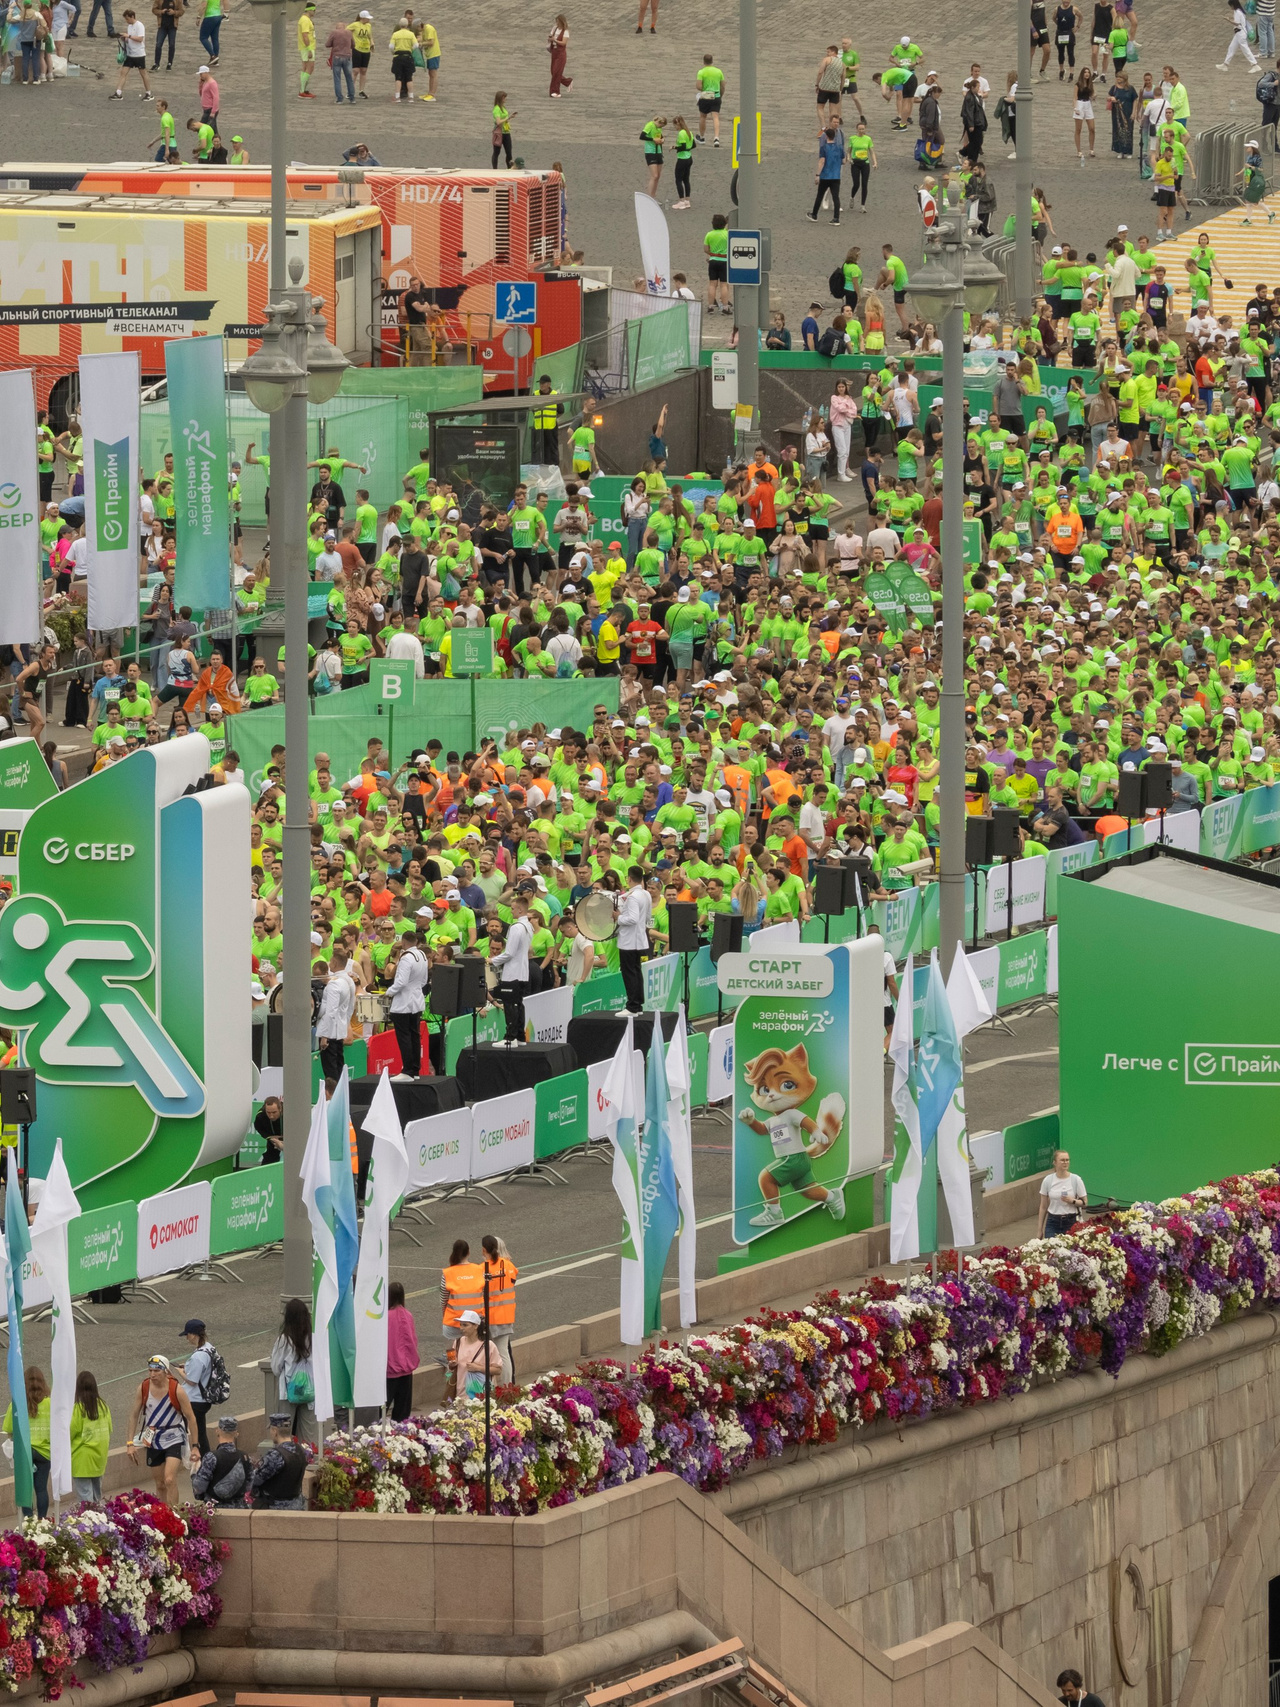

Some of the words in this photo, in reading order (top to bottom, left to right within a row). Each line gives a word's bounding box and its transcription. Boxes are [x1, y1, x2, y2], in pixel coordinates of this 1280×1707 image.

[400, 183, 463, 205] HD//4
[395, 275, 407, 289] ТВ
[41, 307, 114, 321] СПОРТИВНЫЙ
[116, 305, 178, 318] ТЕЛЕКАНАЛ
[113, 321, 185, 334] #ВСЕНАМАТЧ
[103, 453, 122, 516] Прайм
[196, 461, 214, 535] марафон
[74, 842, 135, 862] СБЕР
[886, 897, 911, 933] БЕГИ
[748, 959, 802, 975] СТАРТ
[1007, 952, 1028, 973] зелёный
[727, 976, 784, 990] ДЕТСКИЙ
[785, 979, 824, 992] ЗАБЕГ
[1005, 969, 1027, 989] марафон
[759, 1007, 809, 1022] зелёный
[537, 1023, 563, 1043] ЗАРЯДЬЕ
[752, 1019, 805, 1036] марафон
[1101, 1053, 1163, 1071] Легче
[1168, 1058, 1179, 1071] с
[1221, 1054, 1280, 1077] Прайм
[488, 1129, 504, 1148] СБЕР
[504, 1119, 530, 1142] МОБАЙЛ
[773, 1129, 784, 1139] 006
[428, 1142, 445, 1161] СБЕР
[445, 1139, 460, 1157] KIDS
[231, 1186, 261, 1210] зелёный
[159, 1214, 199, 1245] самокат
[226, 1207, 258, 1233] марафон
[83, 1224, 111, 1249] зелёный
[79, 1247, 108, 1271] марафон
